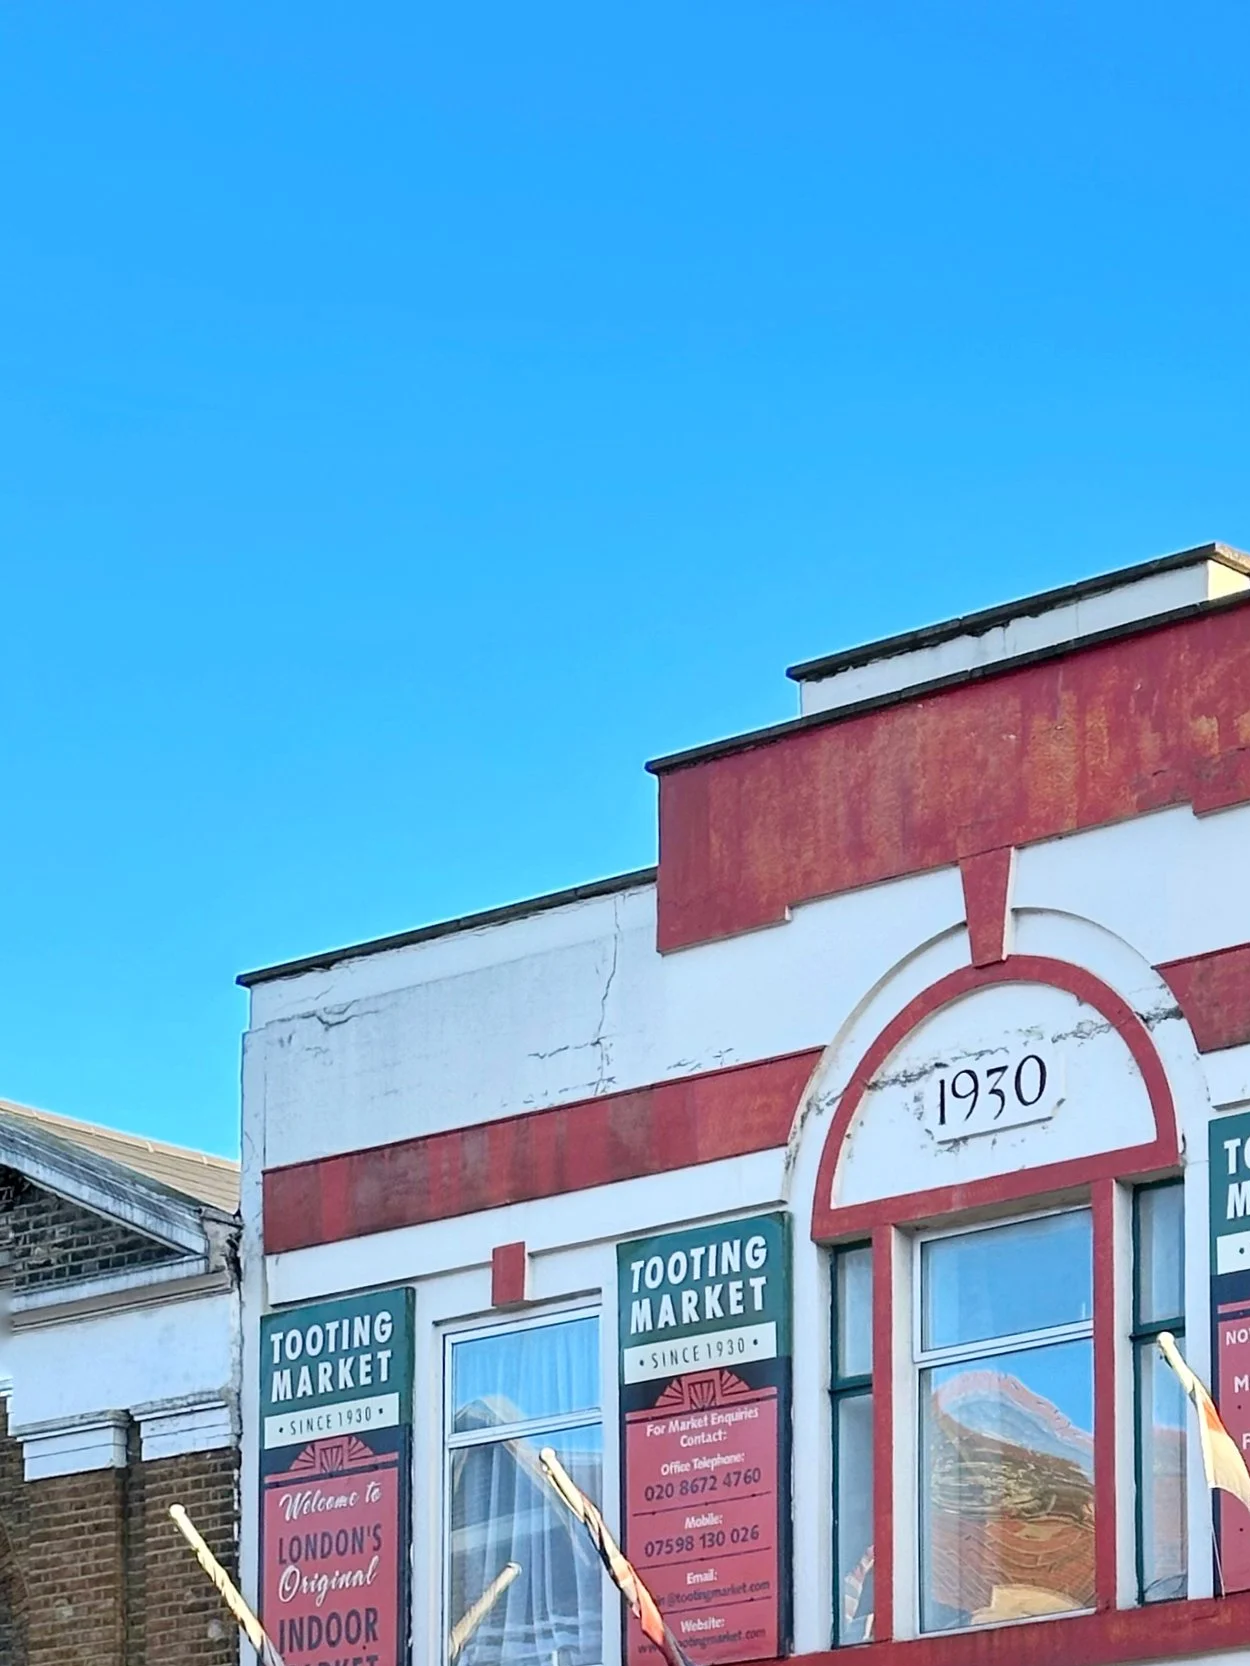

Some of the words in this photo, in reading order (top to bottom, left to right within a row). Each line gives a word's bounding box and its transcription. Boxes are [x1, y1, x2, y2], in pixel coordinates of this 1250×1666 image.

[938, 1054, 1047, 1125] 1930
[630, 1235, 767, 1294] TOOTING
[630, 1276, 767, 1335] MARKET
[270, 1311, 393, 1364] TOOTING
[651, 1345, 700, 1369] SINCE
[706, 1337, 746, 1359] 1930
[271, 1350, 392, 1403] MARKET
[290, 1414, 332, 1436] SINCE
[338, 1406, 372, 1427] 1930
[646, 1424, 666, 1438] For
[668, 1416, 709, 1434] Market
[711, 1407, 759, 1427] Enquiries
[679, 1429, 728, 1448] Contact:
[660, 1460, 691, 1477] Office
[692, 1452, 746, 1472] Telephone:
[279, 1489, 359, 1521] Welcome
[365, 1481, 382, 1503] to
[644, 1483, 675, 1502] 020
[679, 1475, 718, 1496] 8672
[722, 1467, 762, 1488] 4760
[684, 1513, 724, 1530] Mobile:
[278, 1523, 383, 1566] LONDON'S
[644, 1535, 695, 1558] 07598
[699, 1530, 726, 1549] 130
[730, 1525, 760, 1544] 026
[279, 1555, 379, 1607] Original
[686, 1568, 717, 1585] Email:
[279, 1607, 379, 1654] INDOOR
[680, 1617, 725, 1634] Website:
